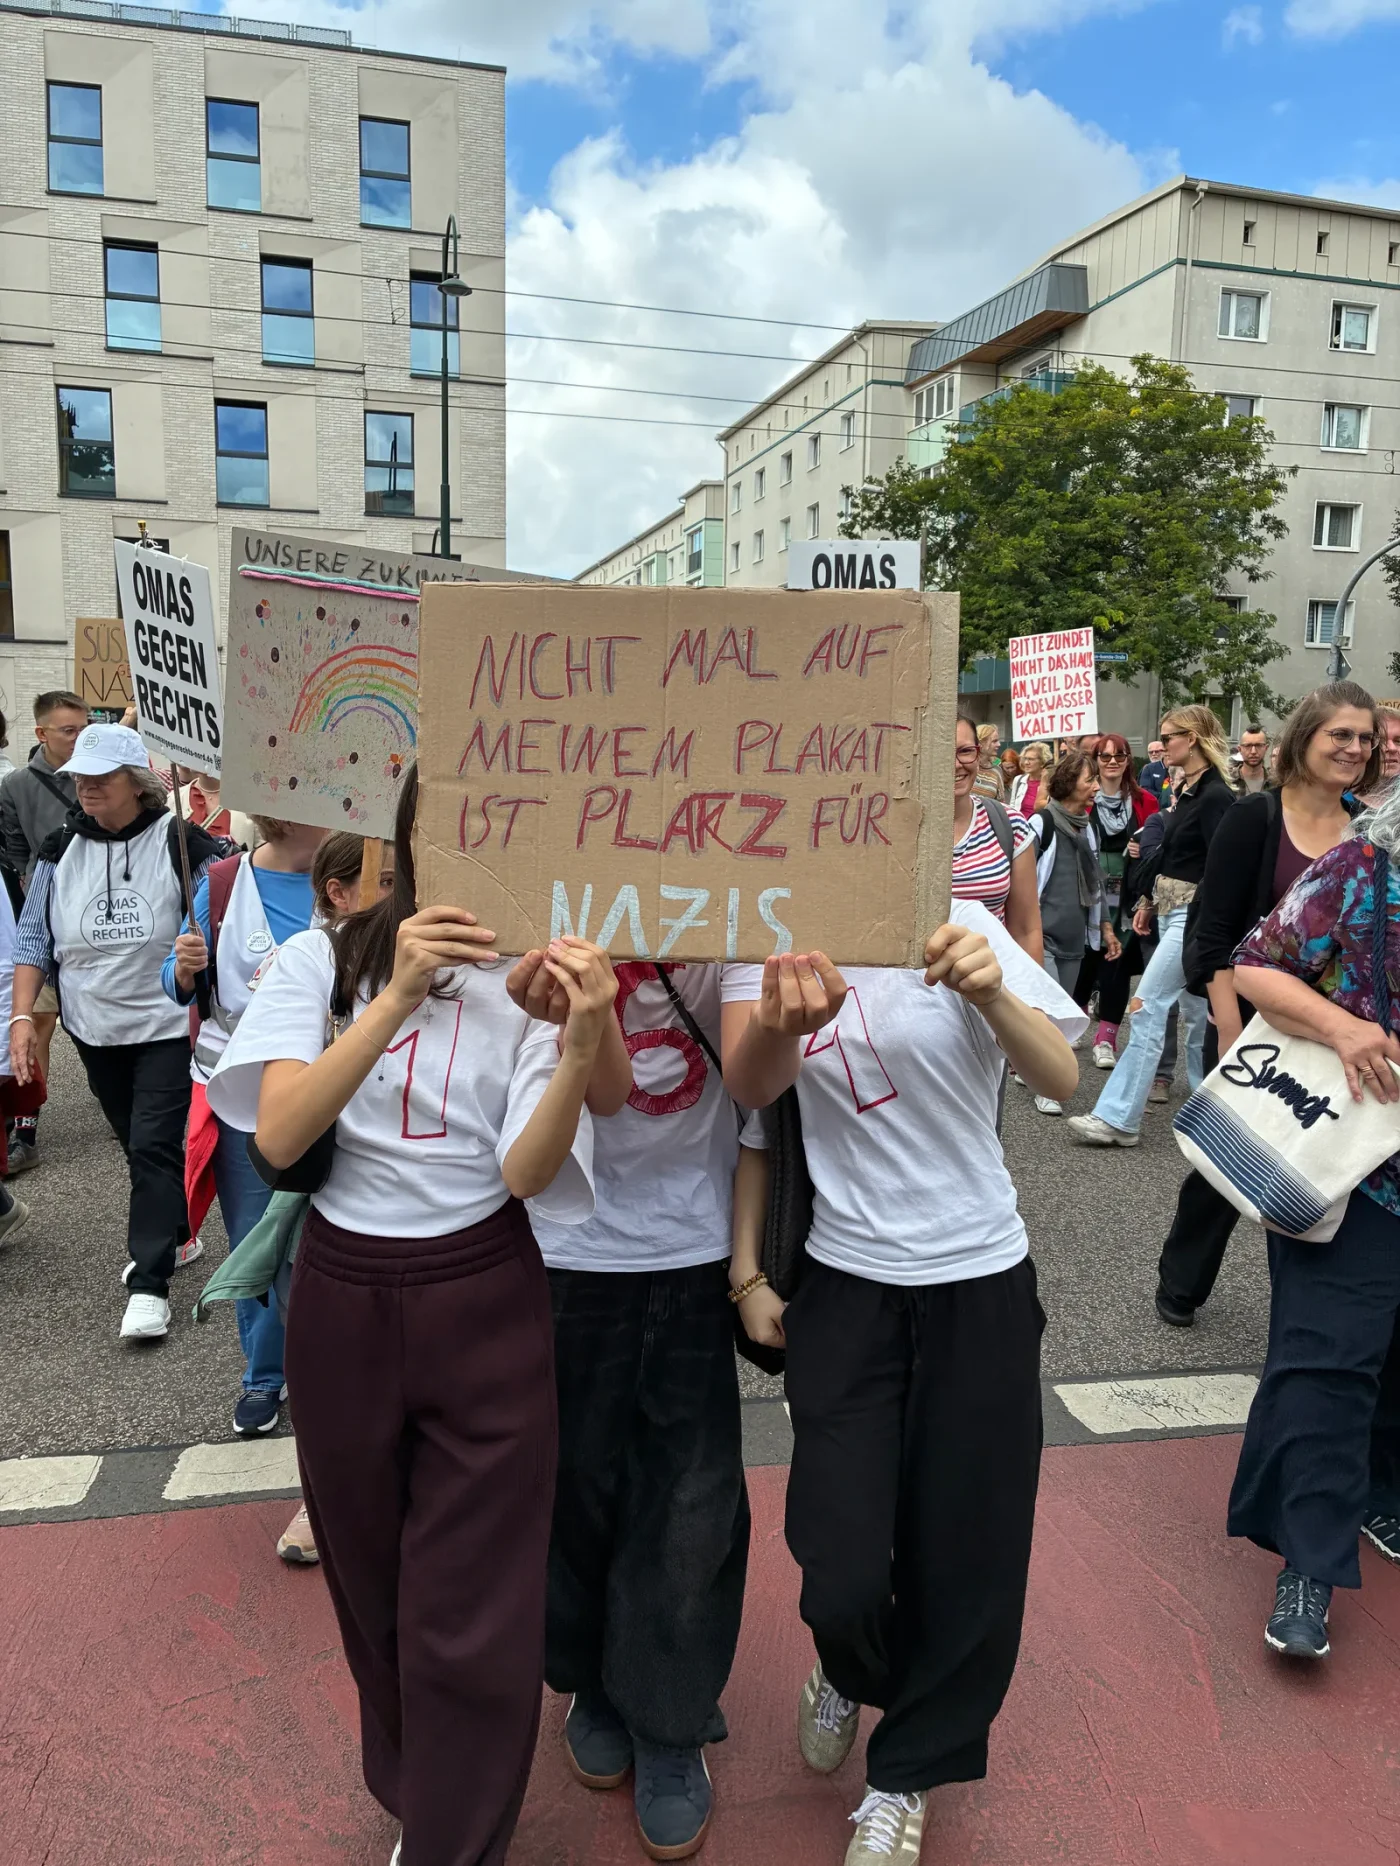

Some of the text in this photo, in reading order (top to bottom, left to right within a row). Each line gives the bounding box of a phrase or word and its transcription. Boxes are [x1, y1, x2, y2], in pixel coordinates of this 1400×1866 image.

[244, 536, 349, 574] UNSERE
[811, 552, 897, 588] OMAS
[132, 560, 195, 627] OMAS
[81, 623, 130, 664] SÜS
[134, 618, 208, 690] GEGEN
[1010, 635, 1045, 659] BITTE
[468, 624, 904, 710] NICHT MAL AUF
[1011, 657, 1045, 678] NICHT
[1048, 653, 1069, 672] DAS
[81, 667, 136, 702] NA
[1012, 671, 1091, 700] AN, WEIL DAS
[135, 673, 221, 749] RECHTS
[1015, 689, 1094, 719] BADEWASSER
[1020, 711, 1086, 738] KALT IST
[457, 718, 912, 778] MEINEM PLAKAT
[458, 794, 548, 852] IST
[810, 782, 893, 848] FÜR
[94, 911, 140, 926] GEGEN
[96, 896, 138, 911] OMAS
[550, 880, 793, 960] NAZIS
[92, 926, 145, 941] RECHTS
